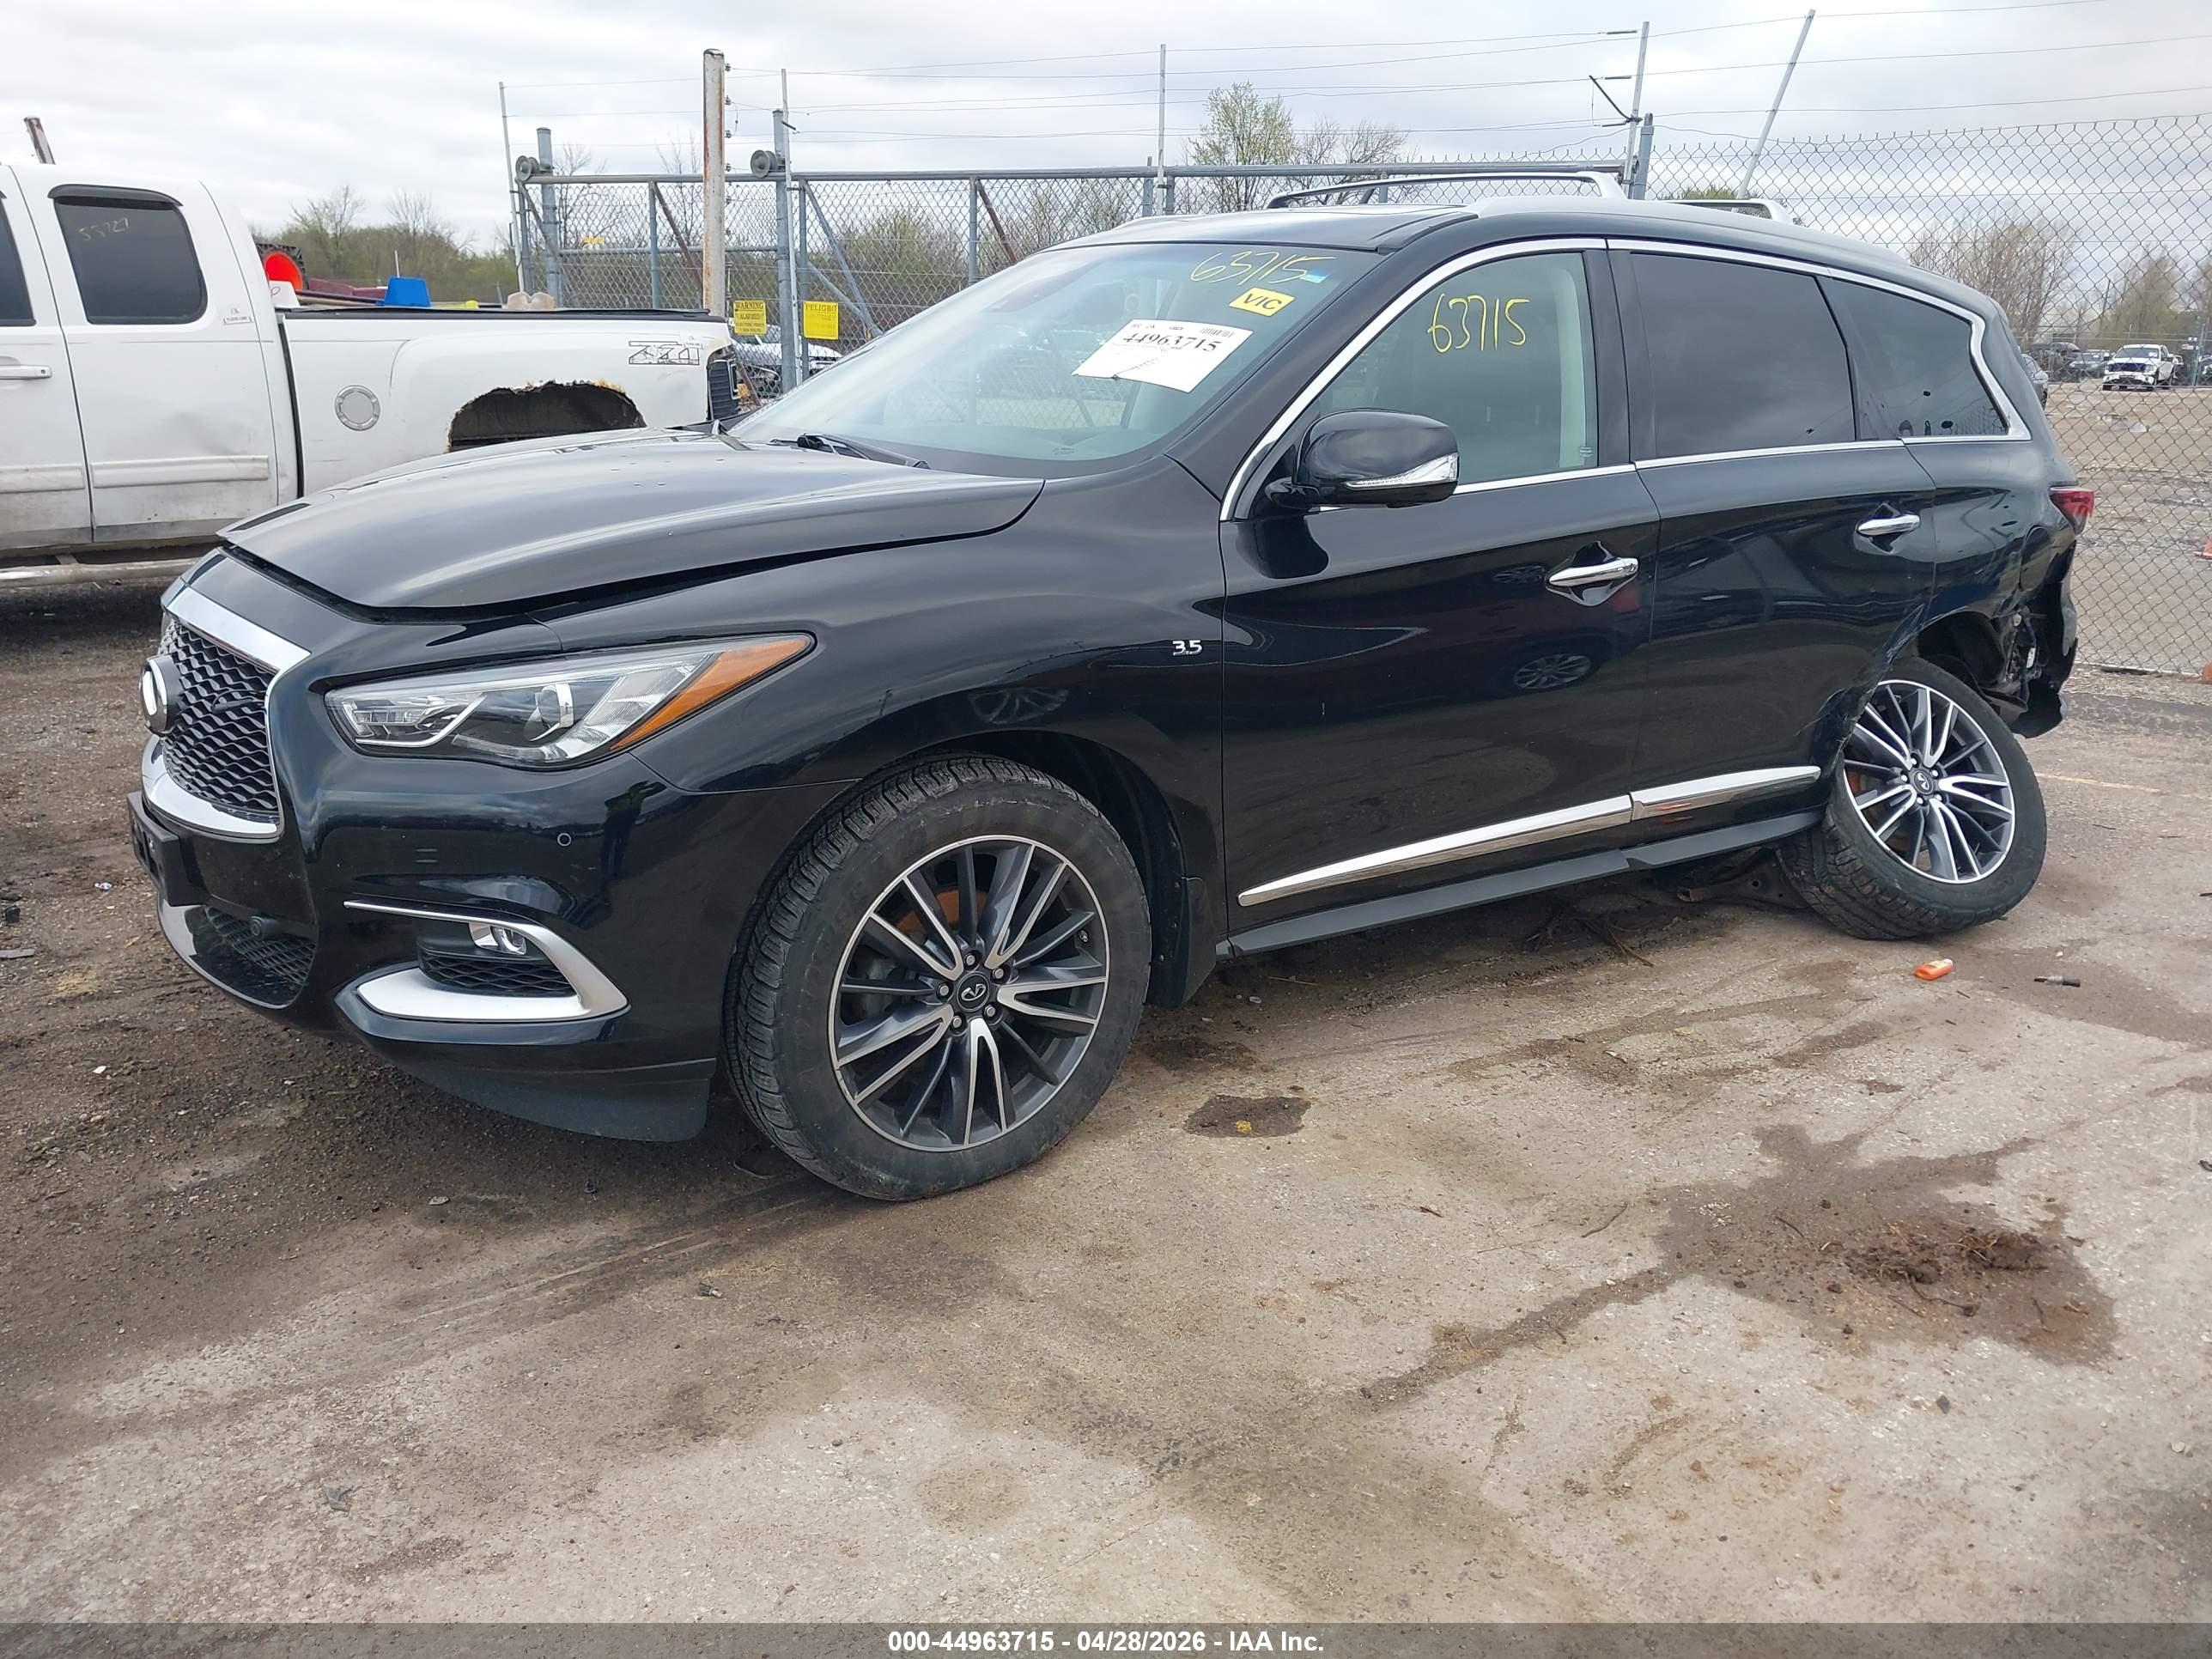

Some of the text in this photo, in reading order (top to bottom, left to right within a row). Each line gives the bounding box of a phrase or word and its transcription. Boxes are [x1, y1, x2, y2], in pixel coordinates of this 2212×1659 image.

[1190, 251, 1337, 286] 63715
[735, 301, 763, 310] WARNING
[805, 302, 838, 312] PELIGRO
[1242, 292, 1284, 311] VIC
[1427, 293, 1531, 354] 63715
[1123, 333, 1222, 352] 44963715
